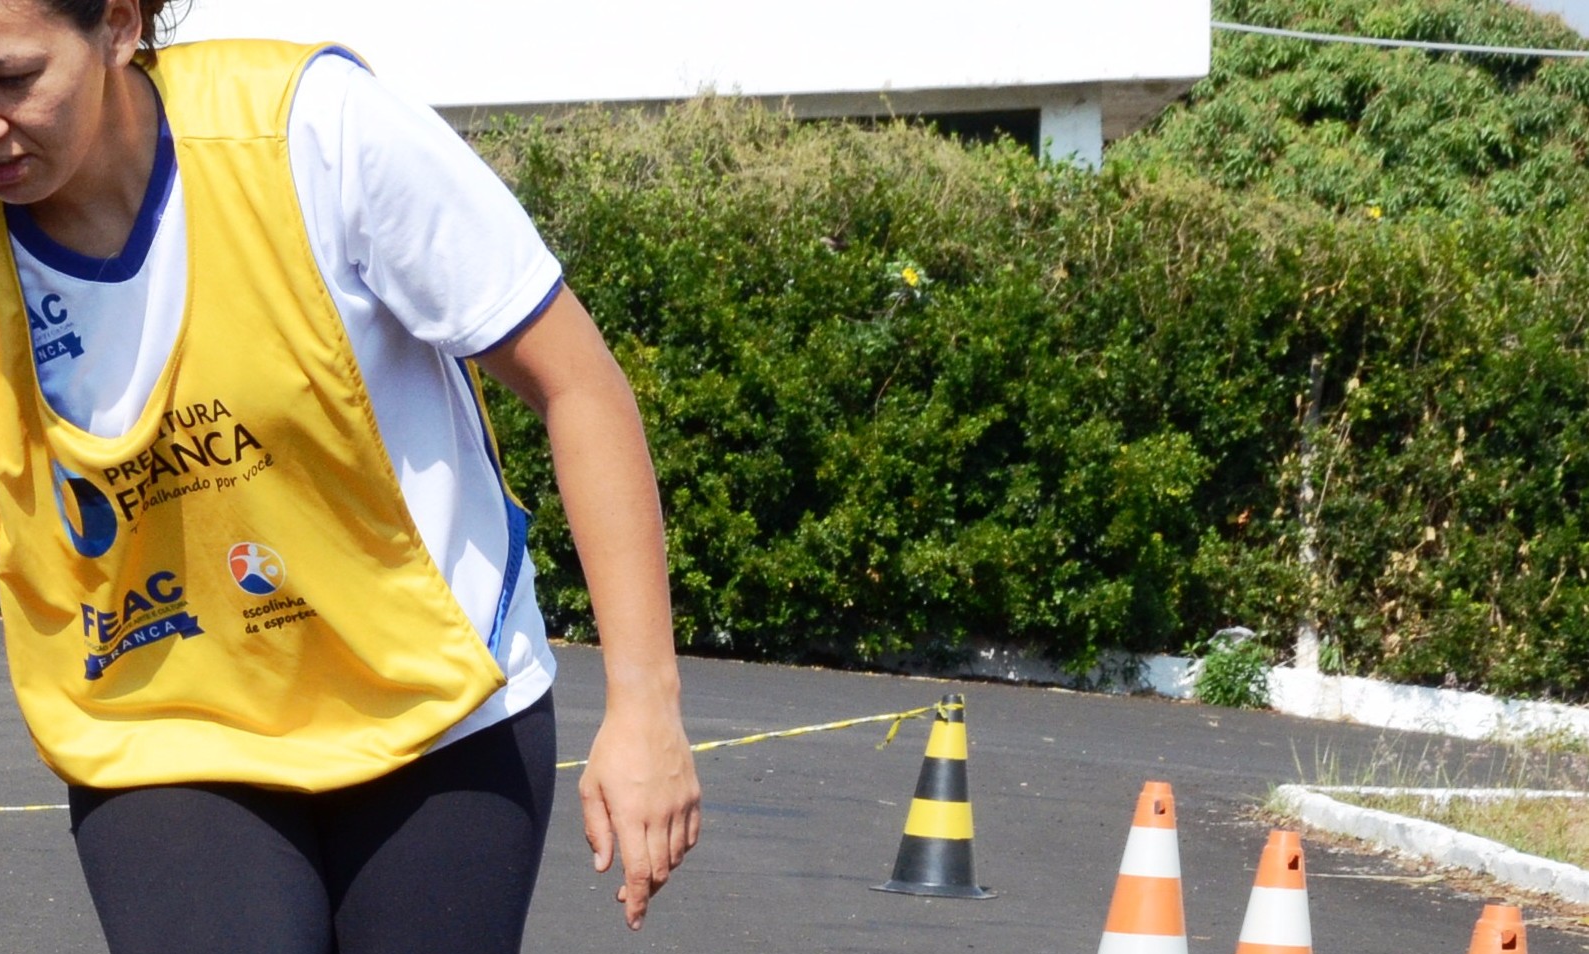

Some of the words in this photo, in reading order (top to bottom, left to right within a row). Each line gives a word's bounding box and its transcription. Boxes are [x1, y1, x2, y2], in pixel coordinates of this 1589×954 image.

[103, 398, 232, 486] PRETURA
[215, 476, 237, 497] por
[81, 571, 183, 644] FEAC
[243, 597, 306, 618] escolinha
[245, 622, 260, 634] de
[264, 609, 318, 629] esportes
[98, 621, 176, 668] FRANCA
